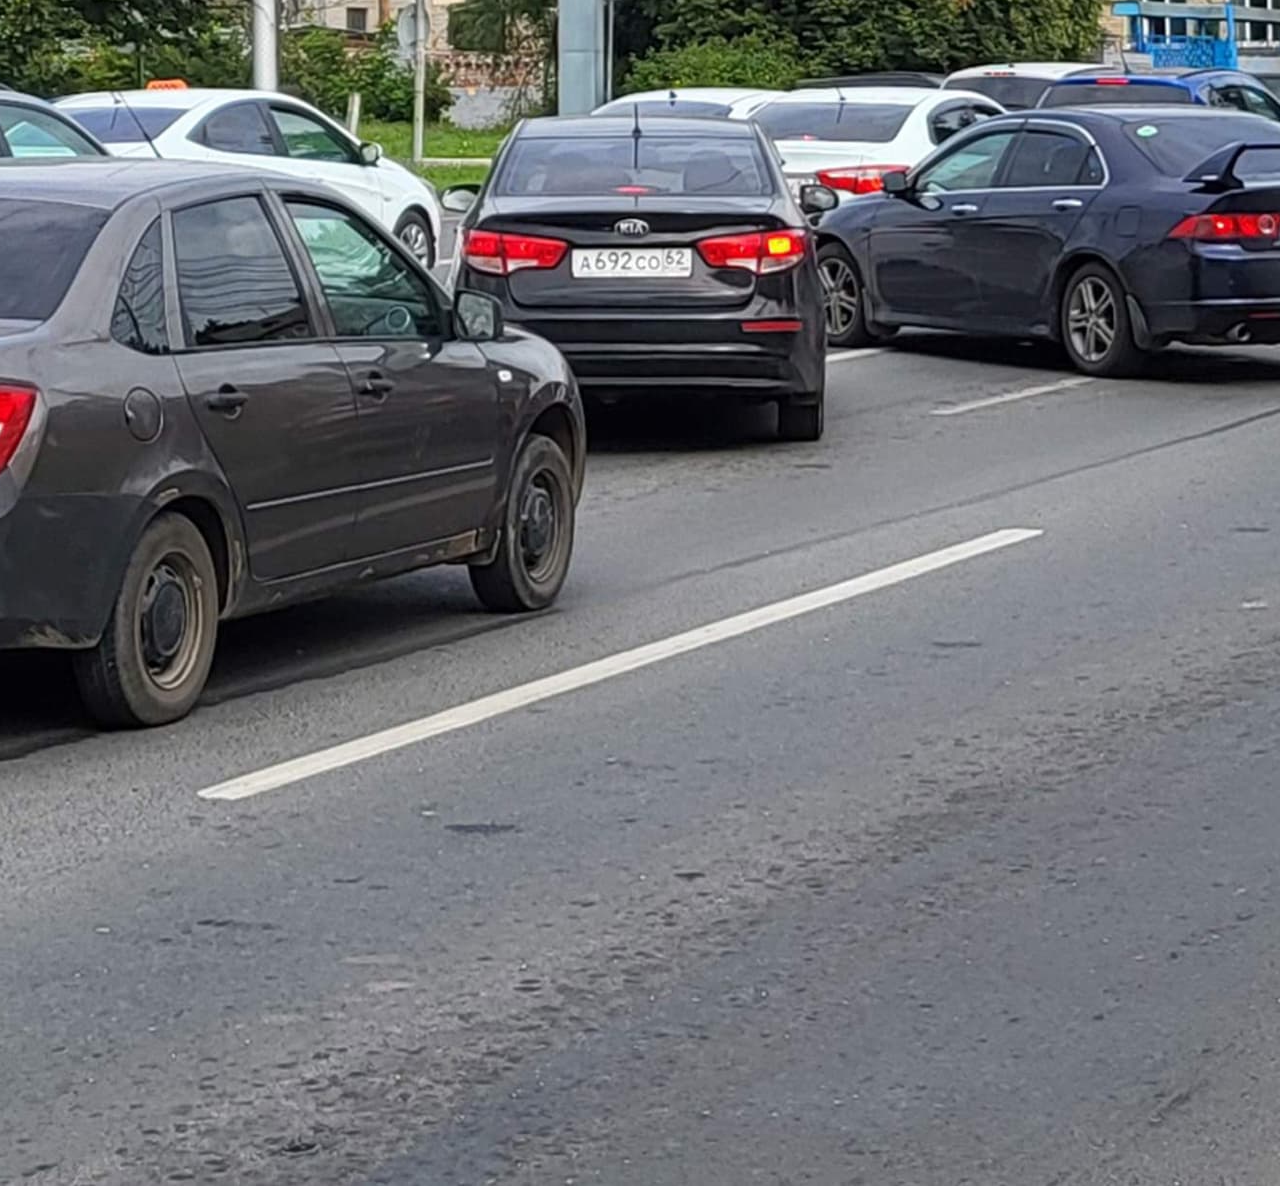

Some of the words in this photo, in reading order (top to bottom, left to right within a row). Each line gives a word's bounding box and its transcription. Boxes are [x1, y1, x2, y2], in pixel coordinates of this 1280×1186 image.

[620, 222, 646, 235] KIA
[581, 251, 660, 270] А692СО
[665, 250, 685, 265] 62
